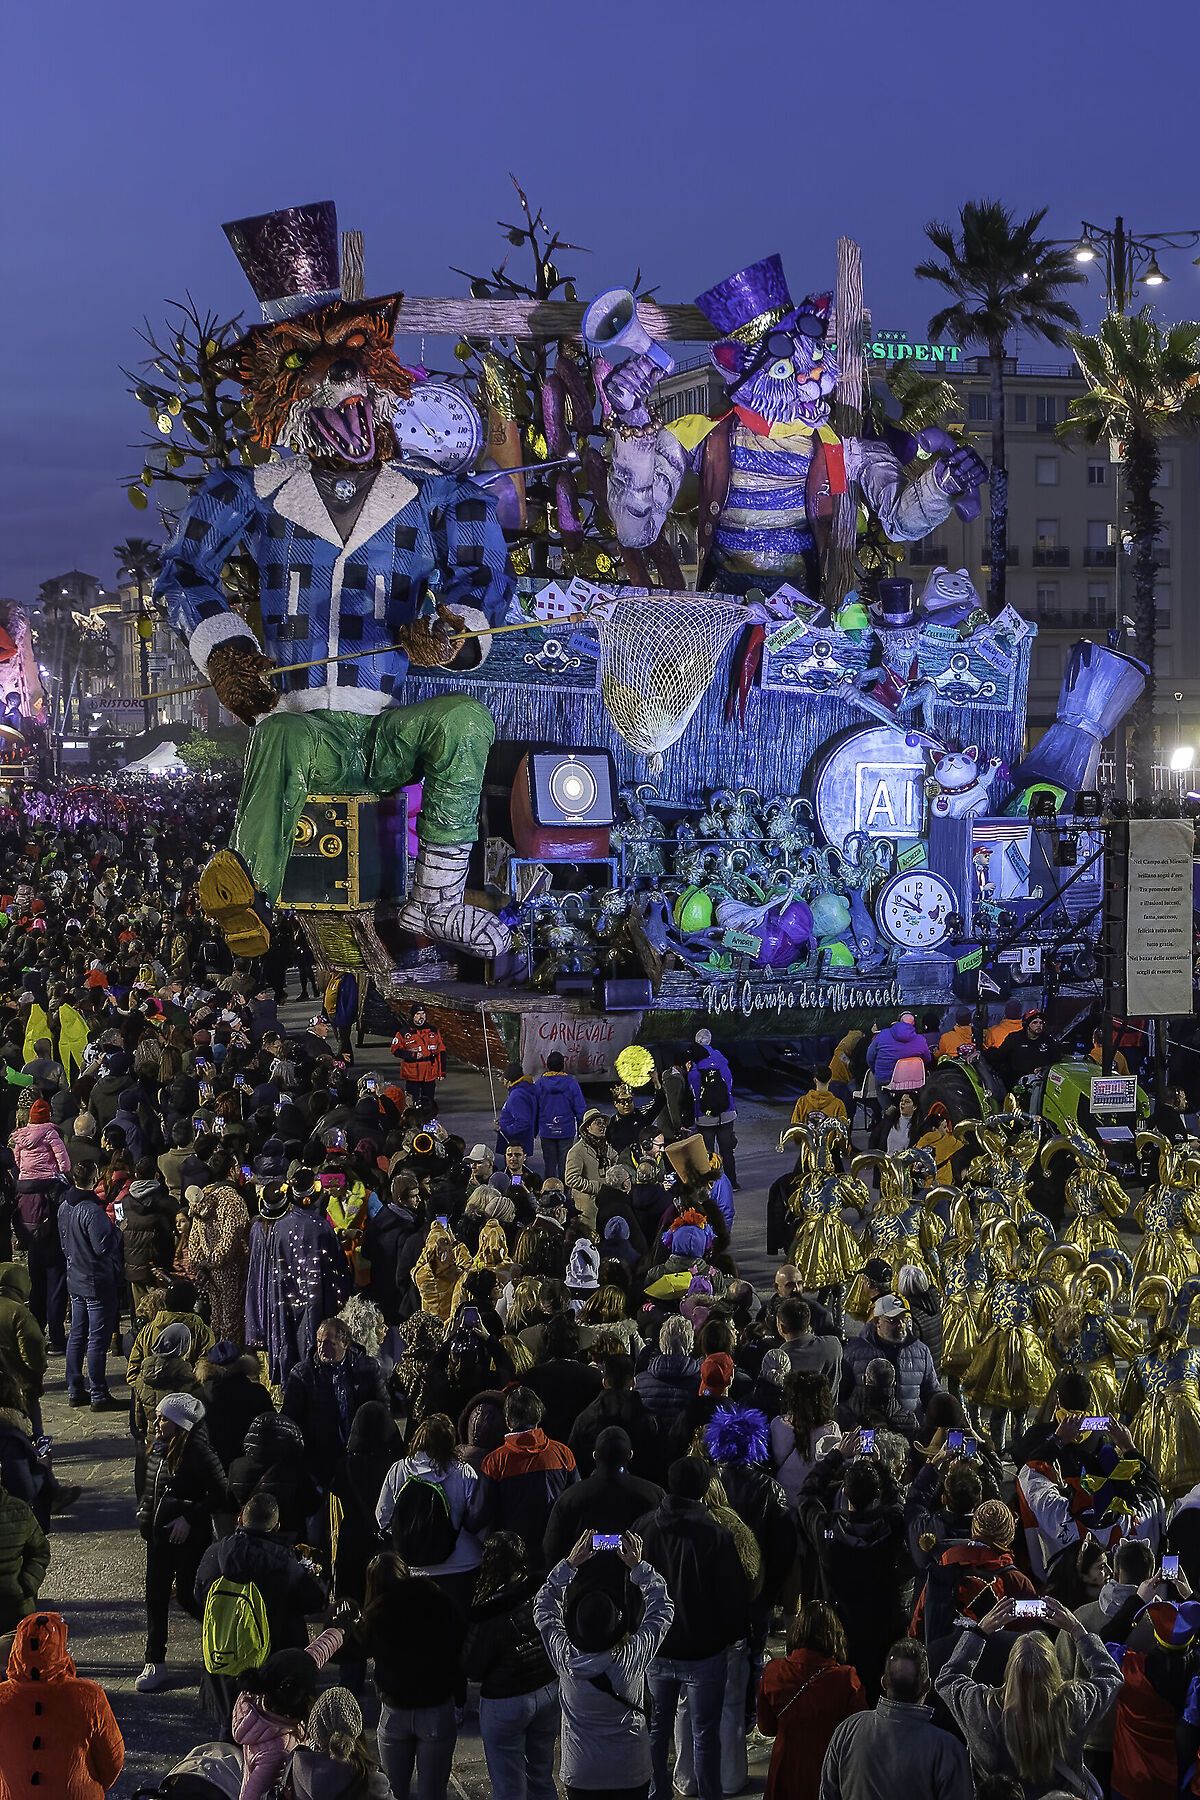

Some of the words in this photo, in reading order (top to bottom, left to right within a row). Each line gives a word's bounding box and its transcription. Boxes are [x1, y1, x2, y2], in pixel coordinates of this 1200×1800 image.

[865, 779, 913, 827] AI
[1027, 956, 1036, 966] 8
[703, 985, 737, 1015] Nel
[741, 980, 795, 1017] Campo
[799, 982, 825, 1009] dei
[827, 980, 904, 1013] Miracoli
[539, 1021, 616, 1045] CARNEVALE
